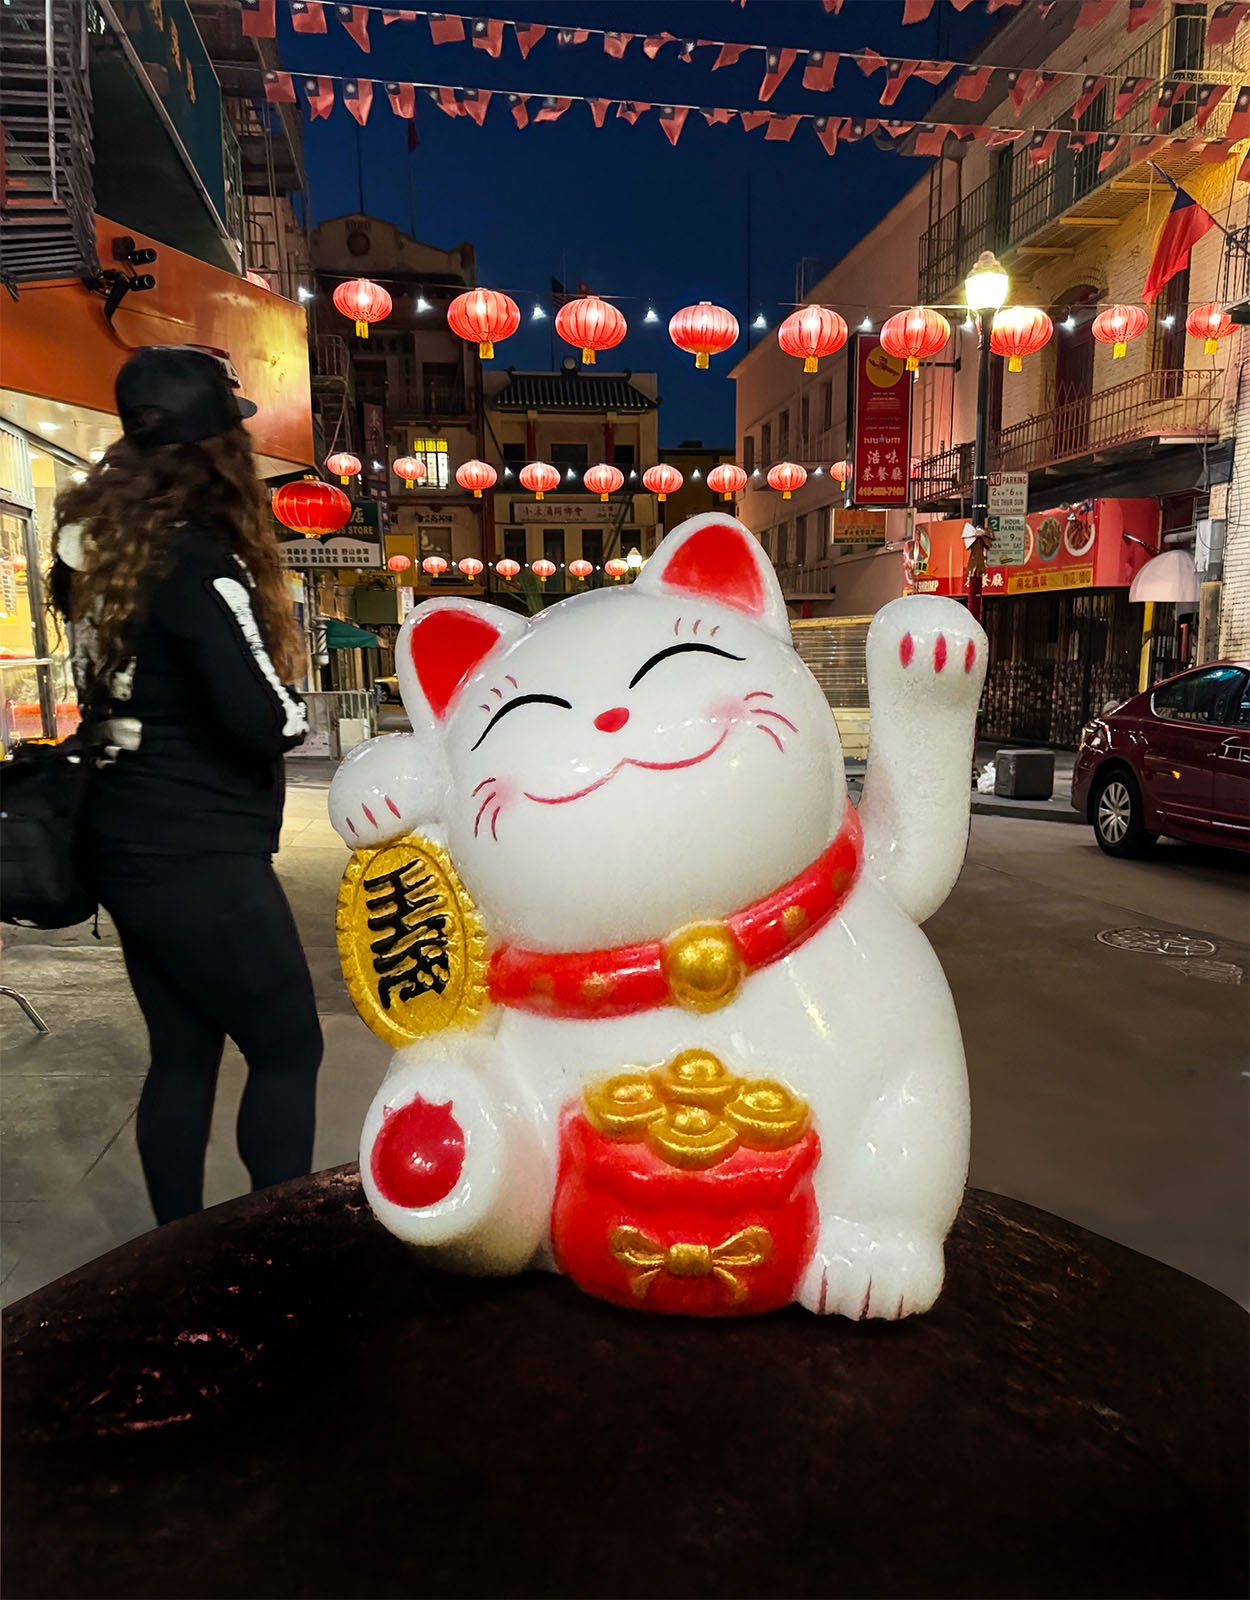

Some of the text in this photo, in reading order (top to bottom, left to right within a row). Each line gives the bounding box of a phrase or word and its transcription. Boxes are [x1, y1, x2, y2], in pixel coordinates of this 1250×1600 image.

[990, 473, 1027, 485] NO PARKING
[348, 525, 374, 535] STORE
[990, 519, 998, 530] 2
[918, 580, 939, 592] SHRIMP
